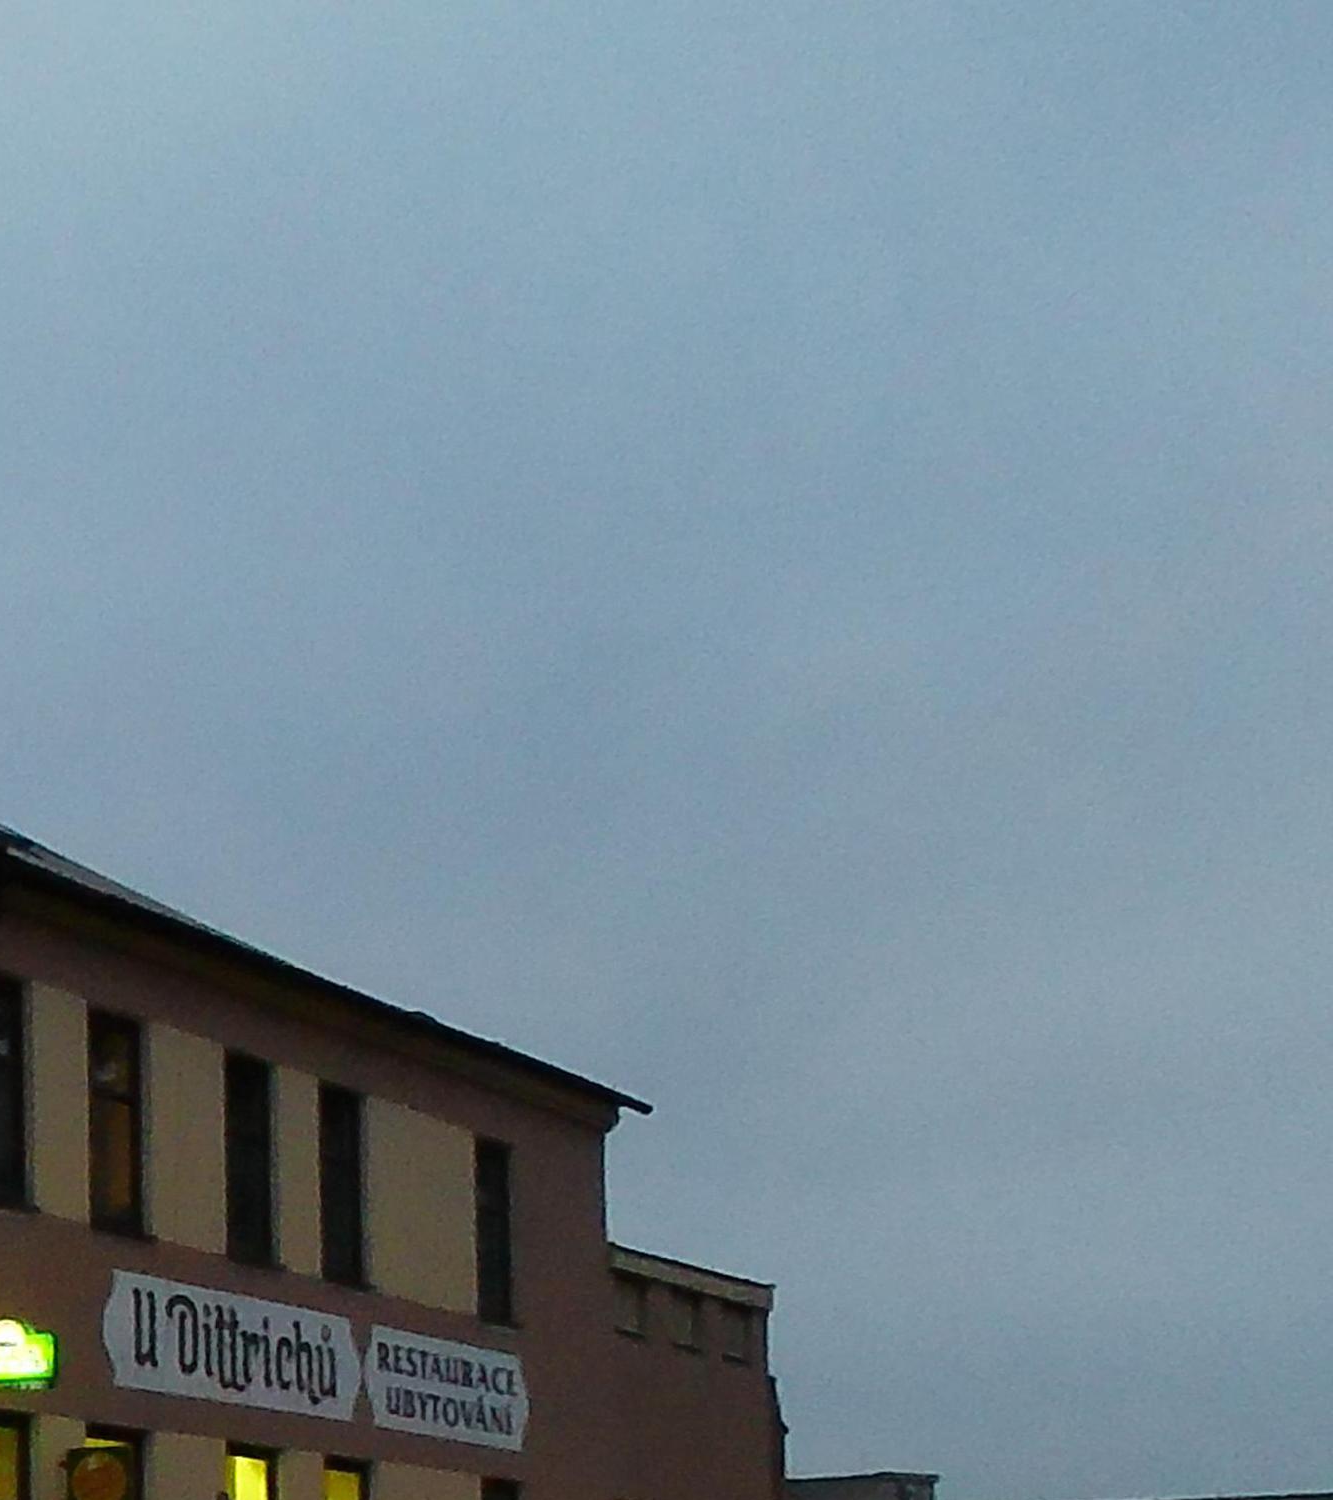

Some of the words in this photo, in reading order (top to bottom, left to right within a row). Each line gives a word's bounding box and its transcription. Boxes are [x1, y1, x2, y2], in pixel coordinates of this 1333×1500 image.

[133, 1287, 158, 1367] U
[165, 1294, 337, 1405] Dittrichů
[377, 1341, 519, 1397] RESTAURACE
